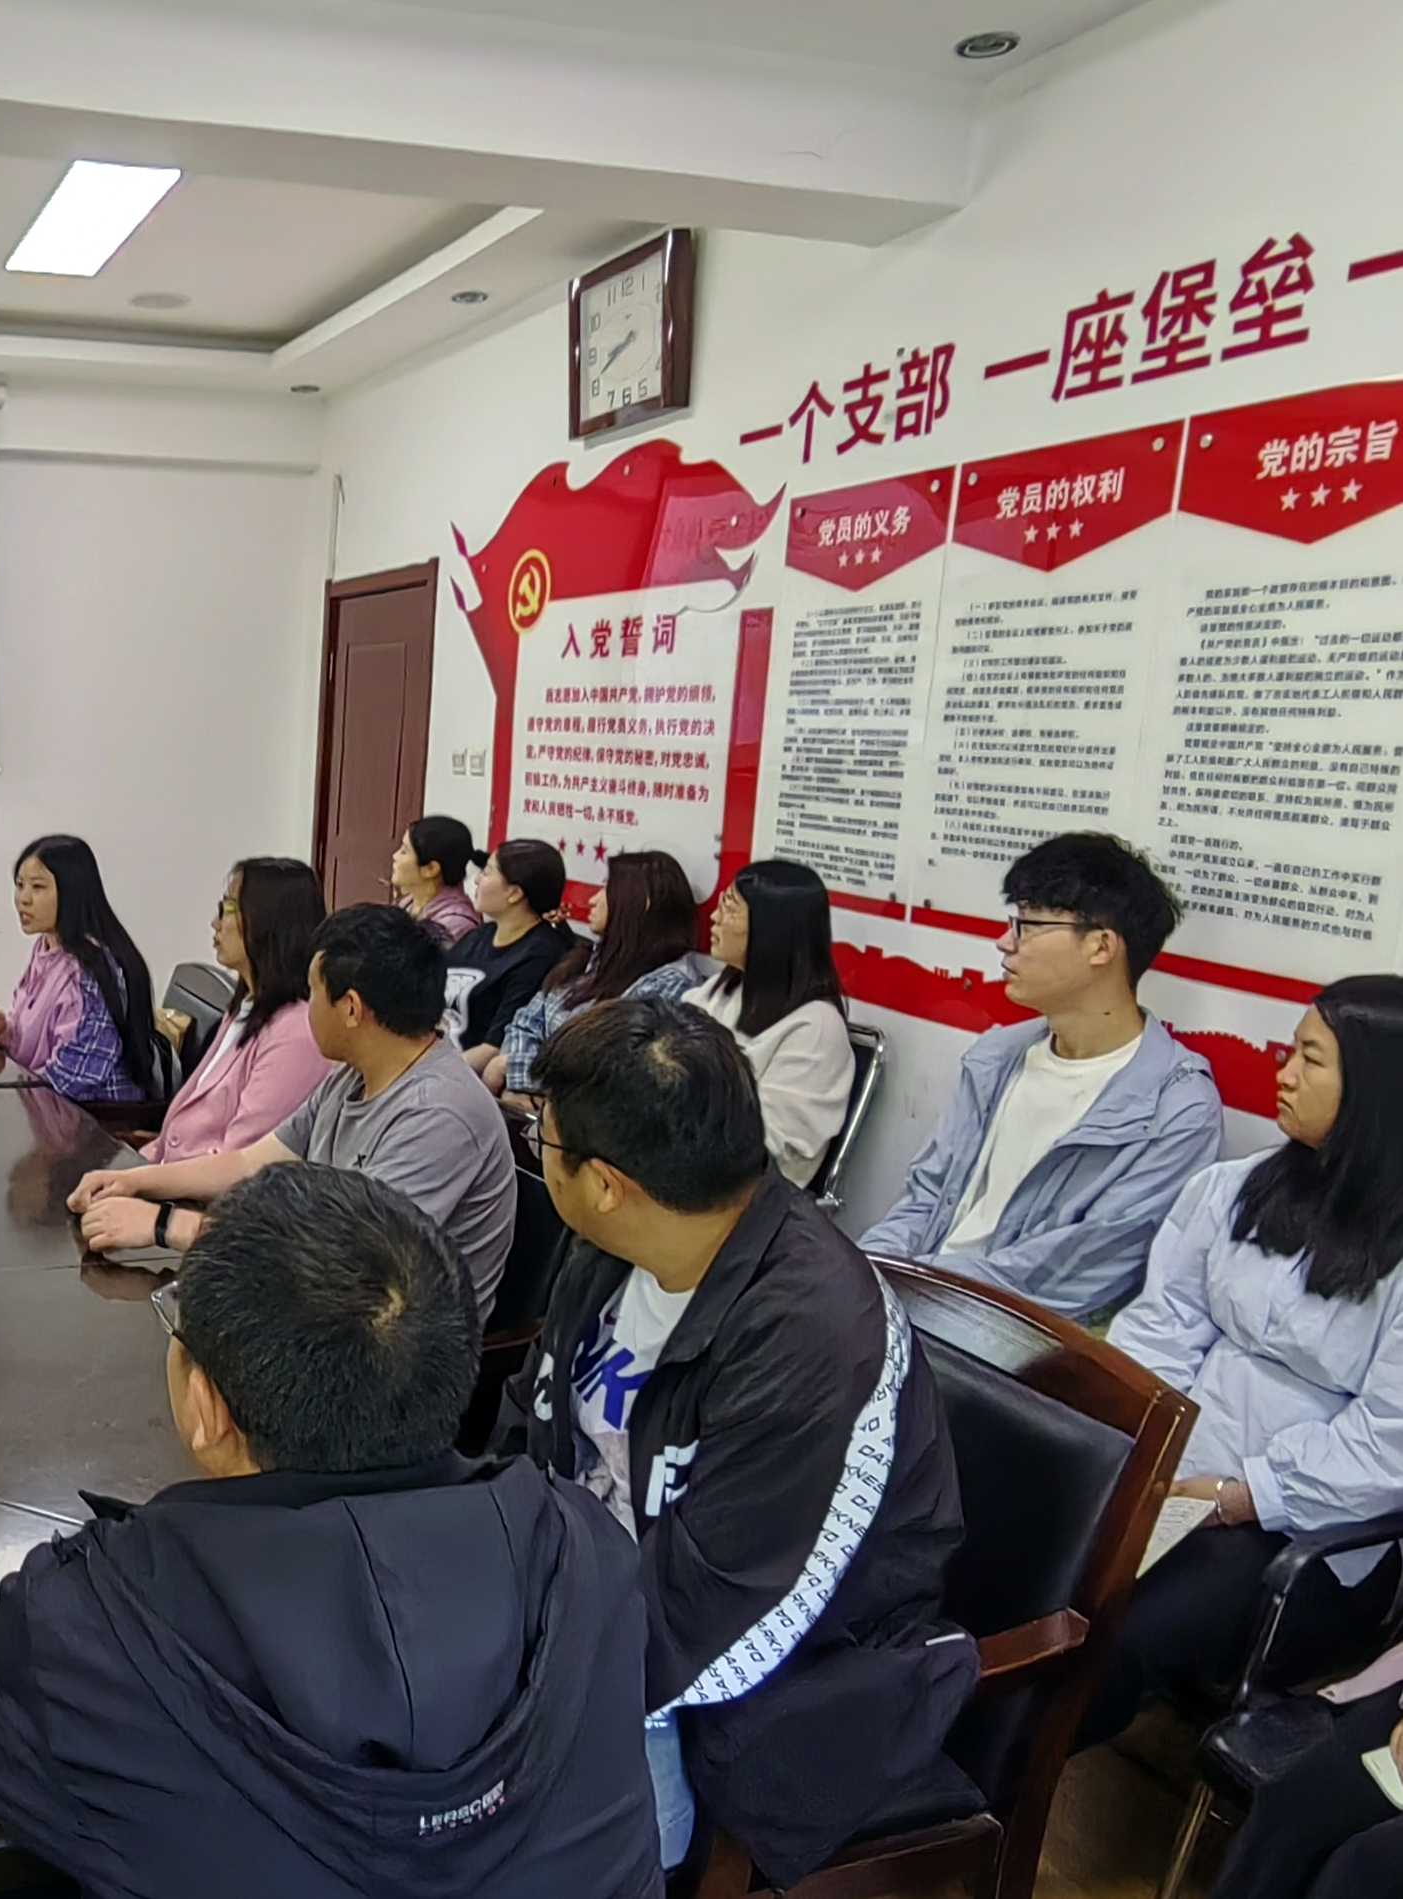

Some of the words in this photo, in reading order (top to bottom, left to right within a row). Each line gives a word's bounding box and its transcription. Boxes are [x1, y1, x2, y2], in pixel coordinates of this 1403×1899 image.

[739, 341, 956, 464] 一个支部
[983, 231, 1316, 403] 一座堡垒
[1255, 419, 1399, 480] 党的宗旨
[995, 466, 1126, 521] 党员的权利
[818, 505, 912, 547] 党员的义务
[561, 613, 678, 660] 入党誓词
